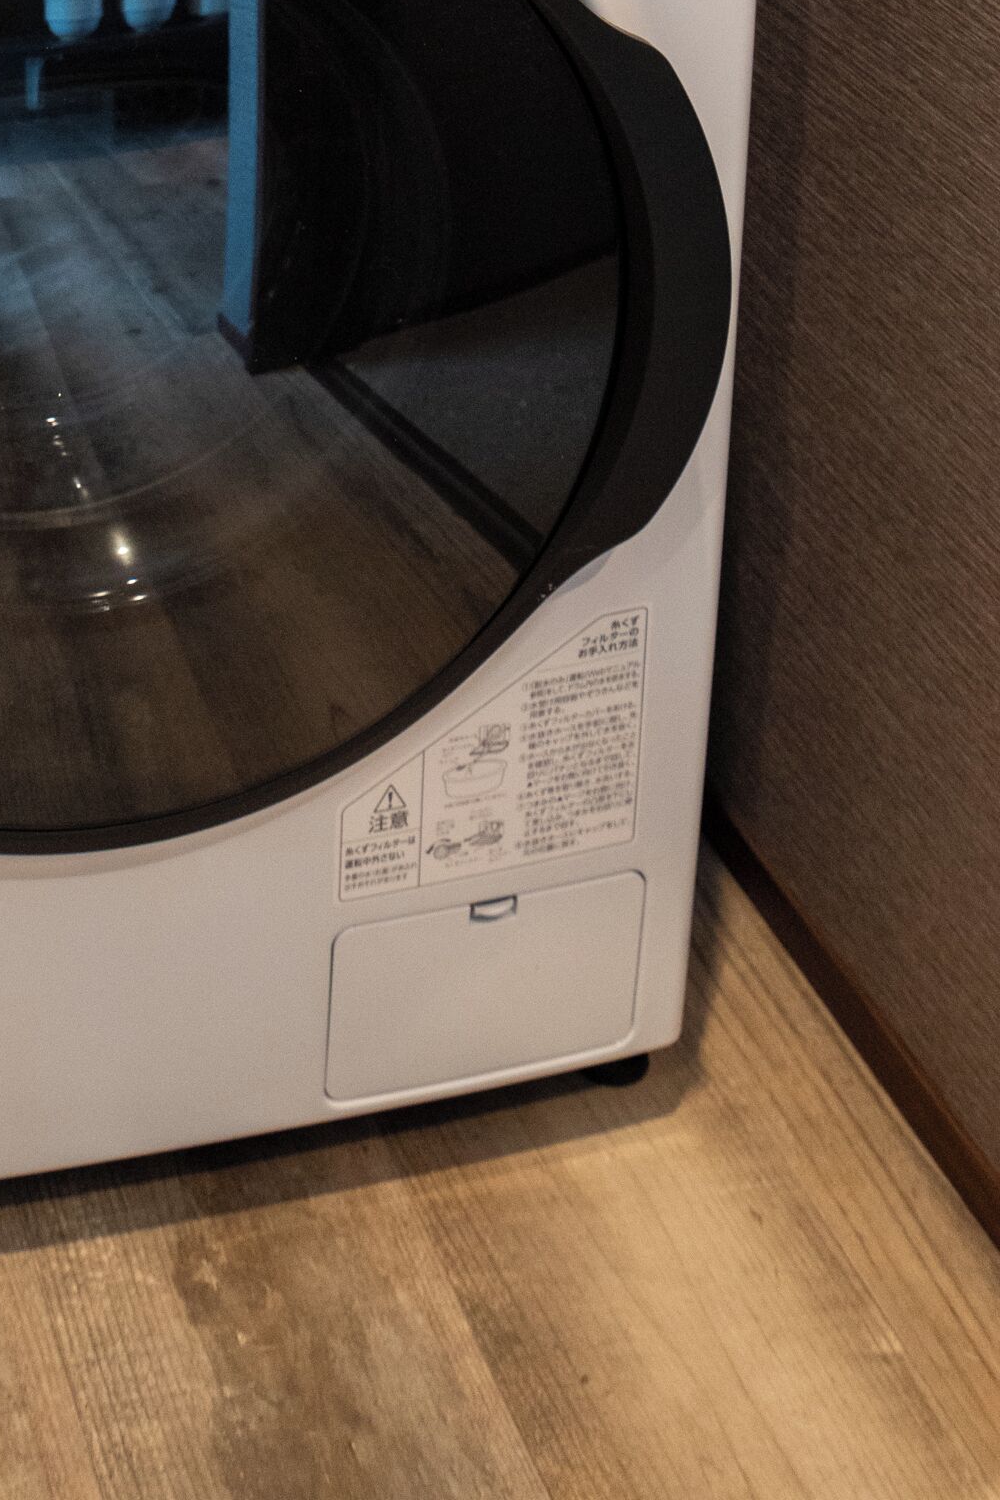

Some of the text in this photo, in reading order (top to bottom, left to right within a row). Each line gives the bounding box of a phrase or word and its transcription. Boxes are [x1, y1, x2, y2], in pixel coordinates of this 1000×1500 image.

[611, 615, 639, 630] 糸くず
[582, 627, 639, 646] フィルターの
[578, 638, 638, 658] お手入れ方法
[369, 810, 408, 833] 注意
[345, 836, 415, 857] 糸くずフィルターは
[345, 851, 405, 869] 運転中外さない
